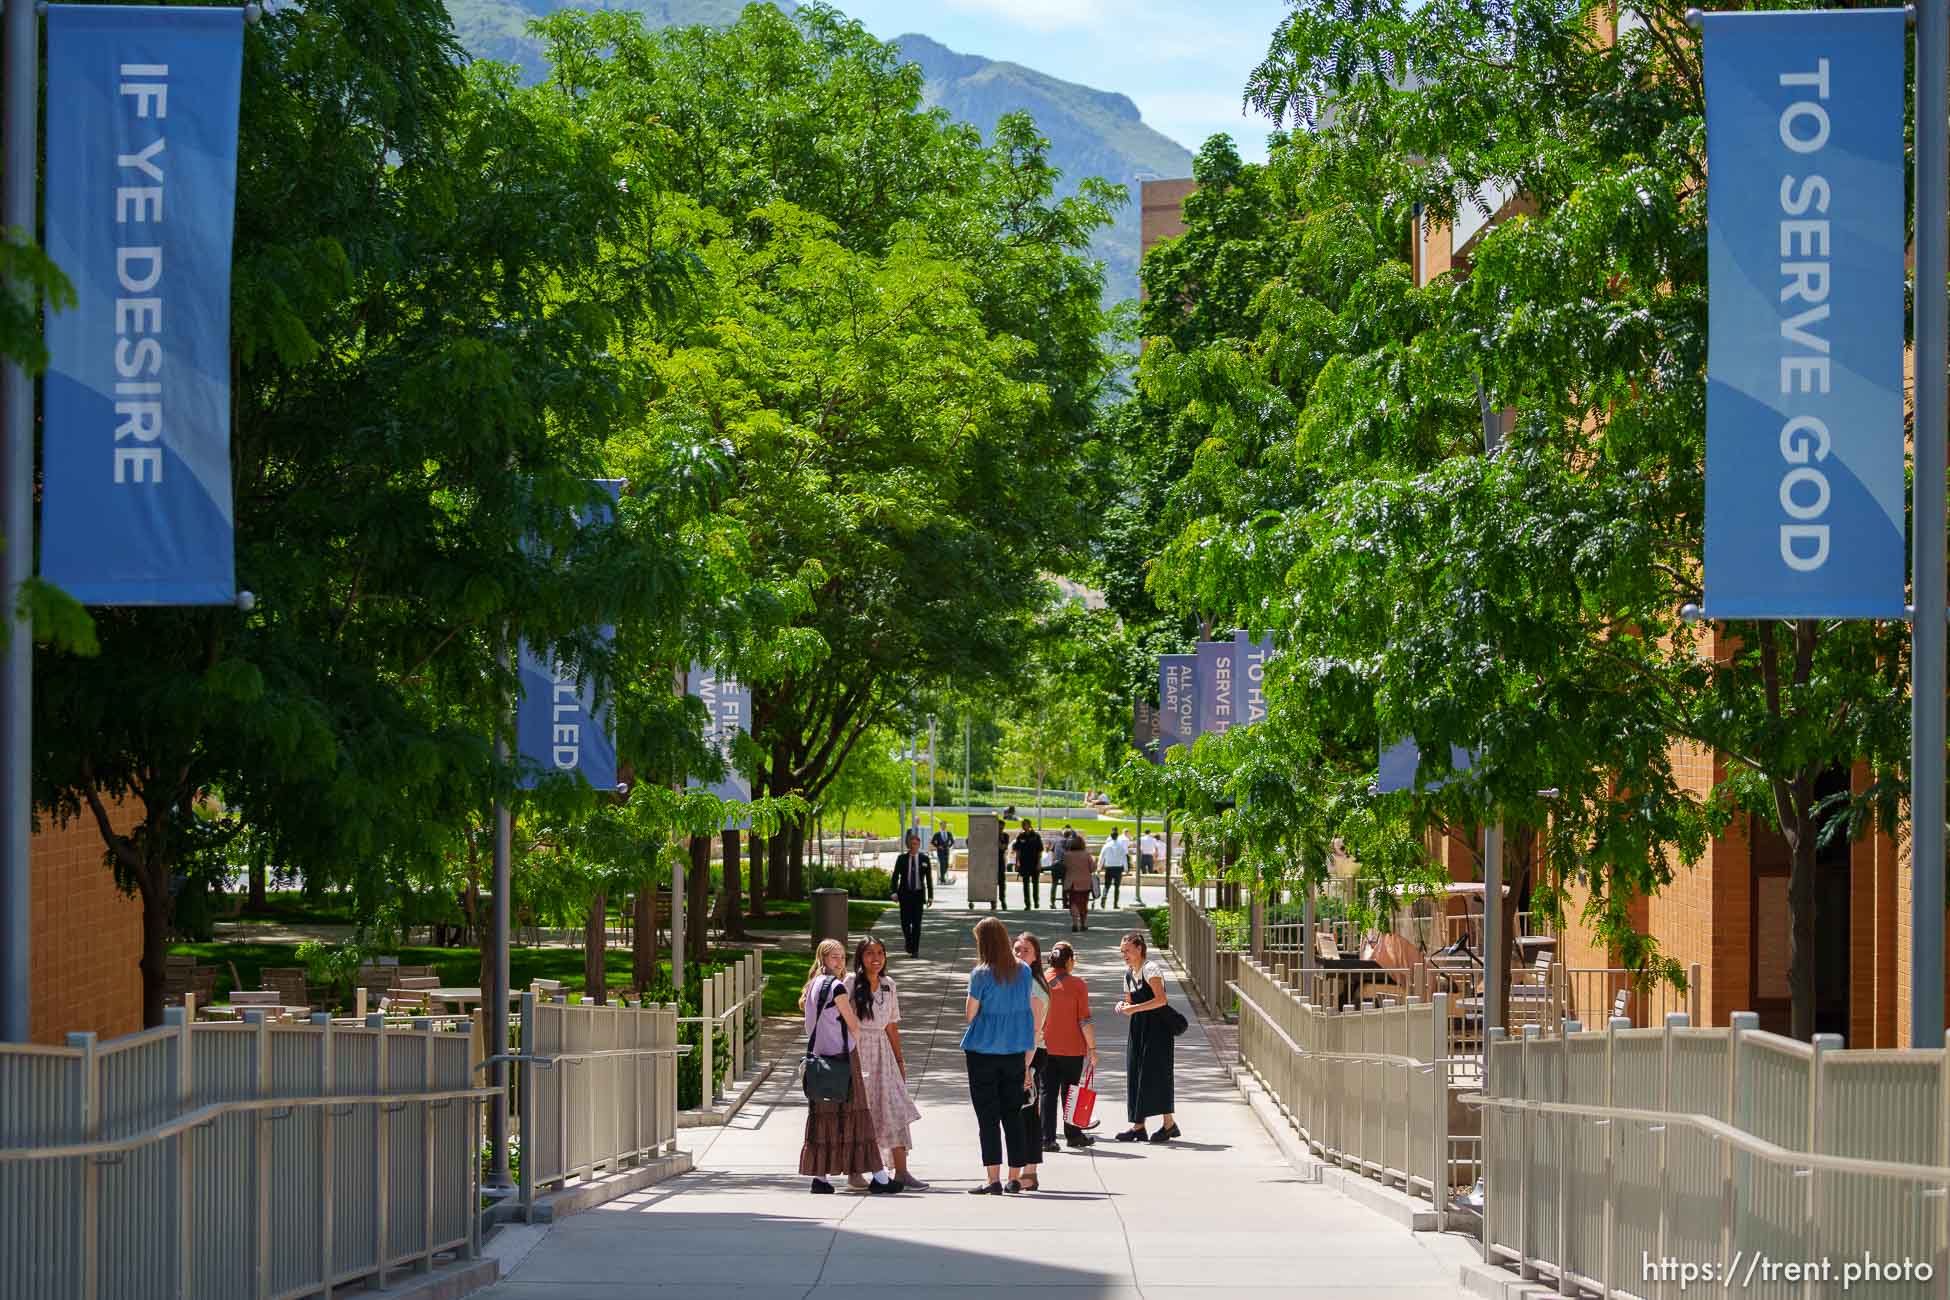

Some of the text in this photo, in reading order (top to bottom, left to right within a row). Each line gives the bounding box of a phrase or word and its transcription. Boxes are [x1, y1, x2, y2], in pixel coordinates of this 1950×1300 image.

[113, 63, 169, 484] IF YE DESIRE
[1779, 57, 1831, 572] TO SERVE GOD
[1166, 665, 1178, 713] HEART
[1179, 664, 1193, 736] ALL YOUR
[1215, 656, 1232, 717] SERVE
[1247, 649, 1265, 726] TO HA
